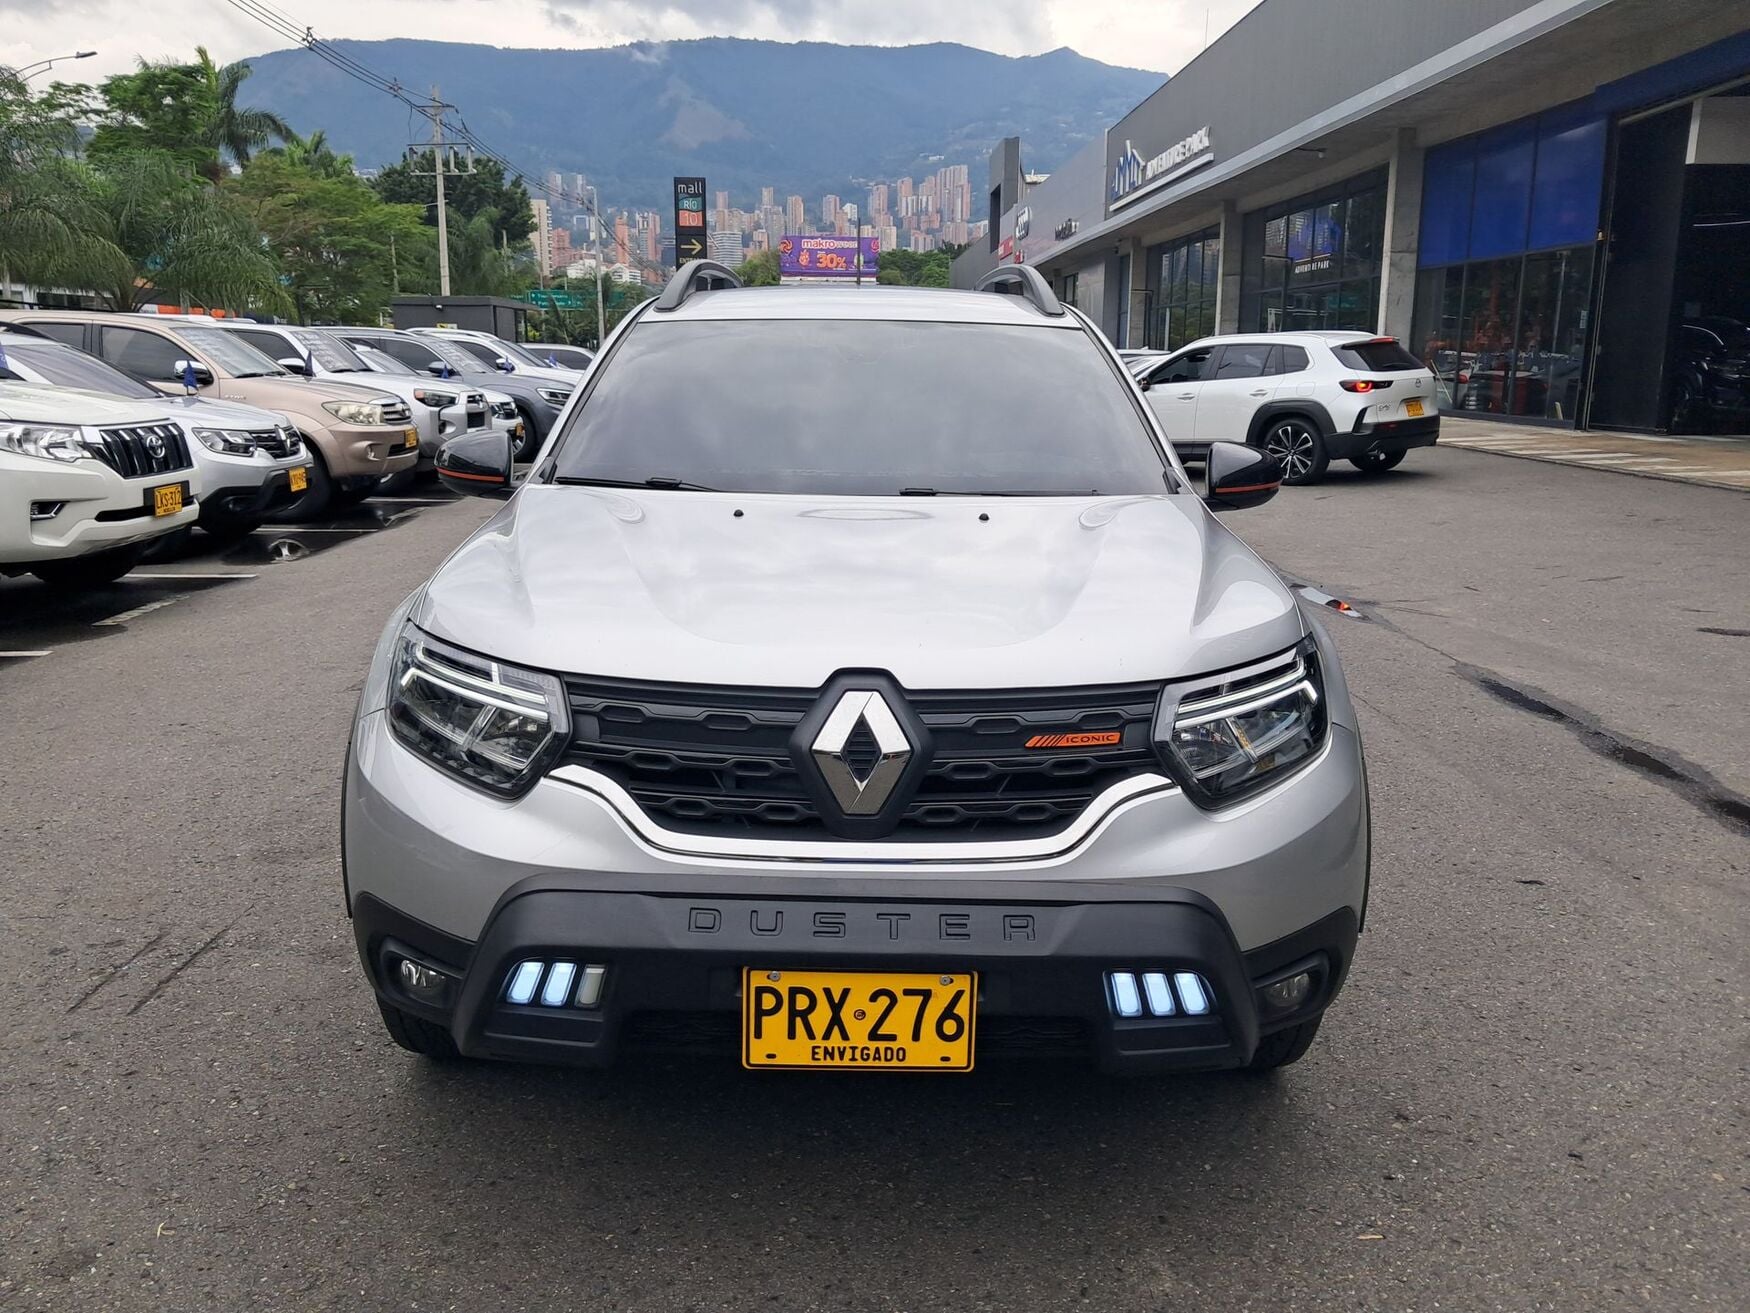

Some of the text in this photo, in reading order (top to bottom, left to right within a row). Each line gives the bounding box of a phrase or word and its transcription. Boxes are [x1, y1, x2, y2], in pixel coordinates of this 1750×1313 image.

[678, 181, 702, 194] mall
[816, 253, 847, 269] 30%
[1066, 734, 1114, 744] ICONIC
[688, 907, 1036, 942] DUSTER
[811, 1045, 907, 1063] ENVIGADO
